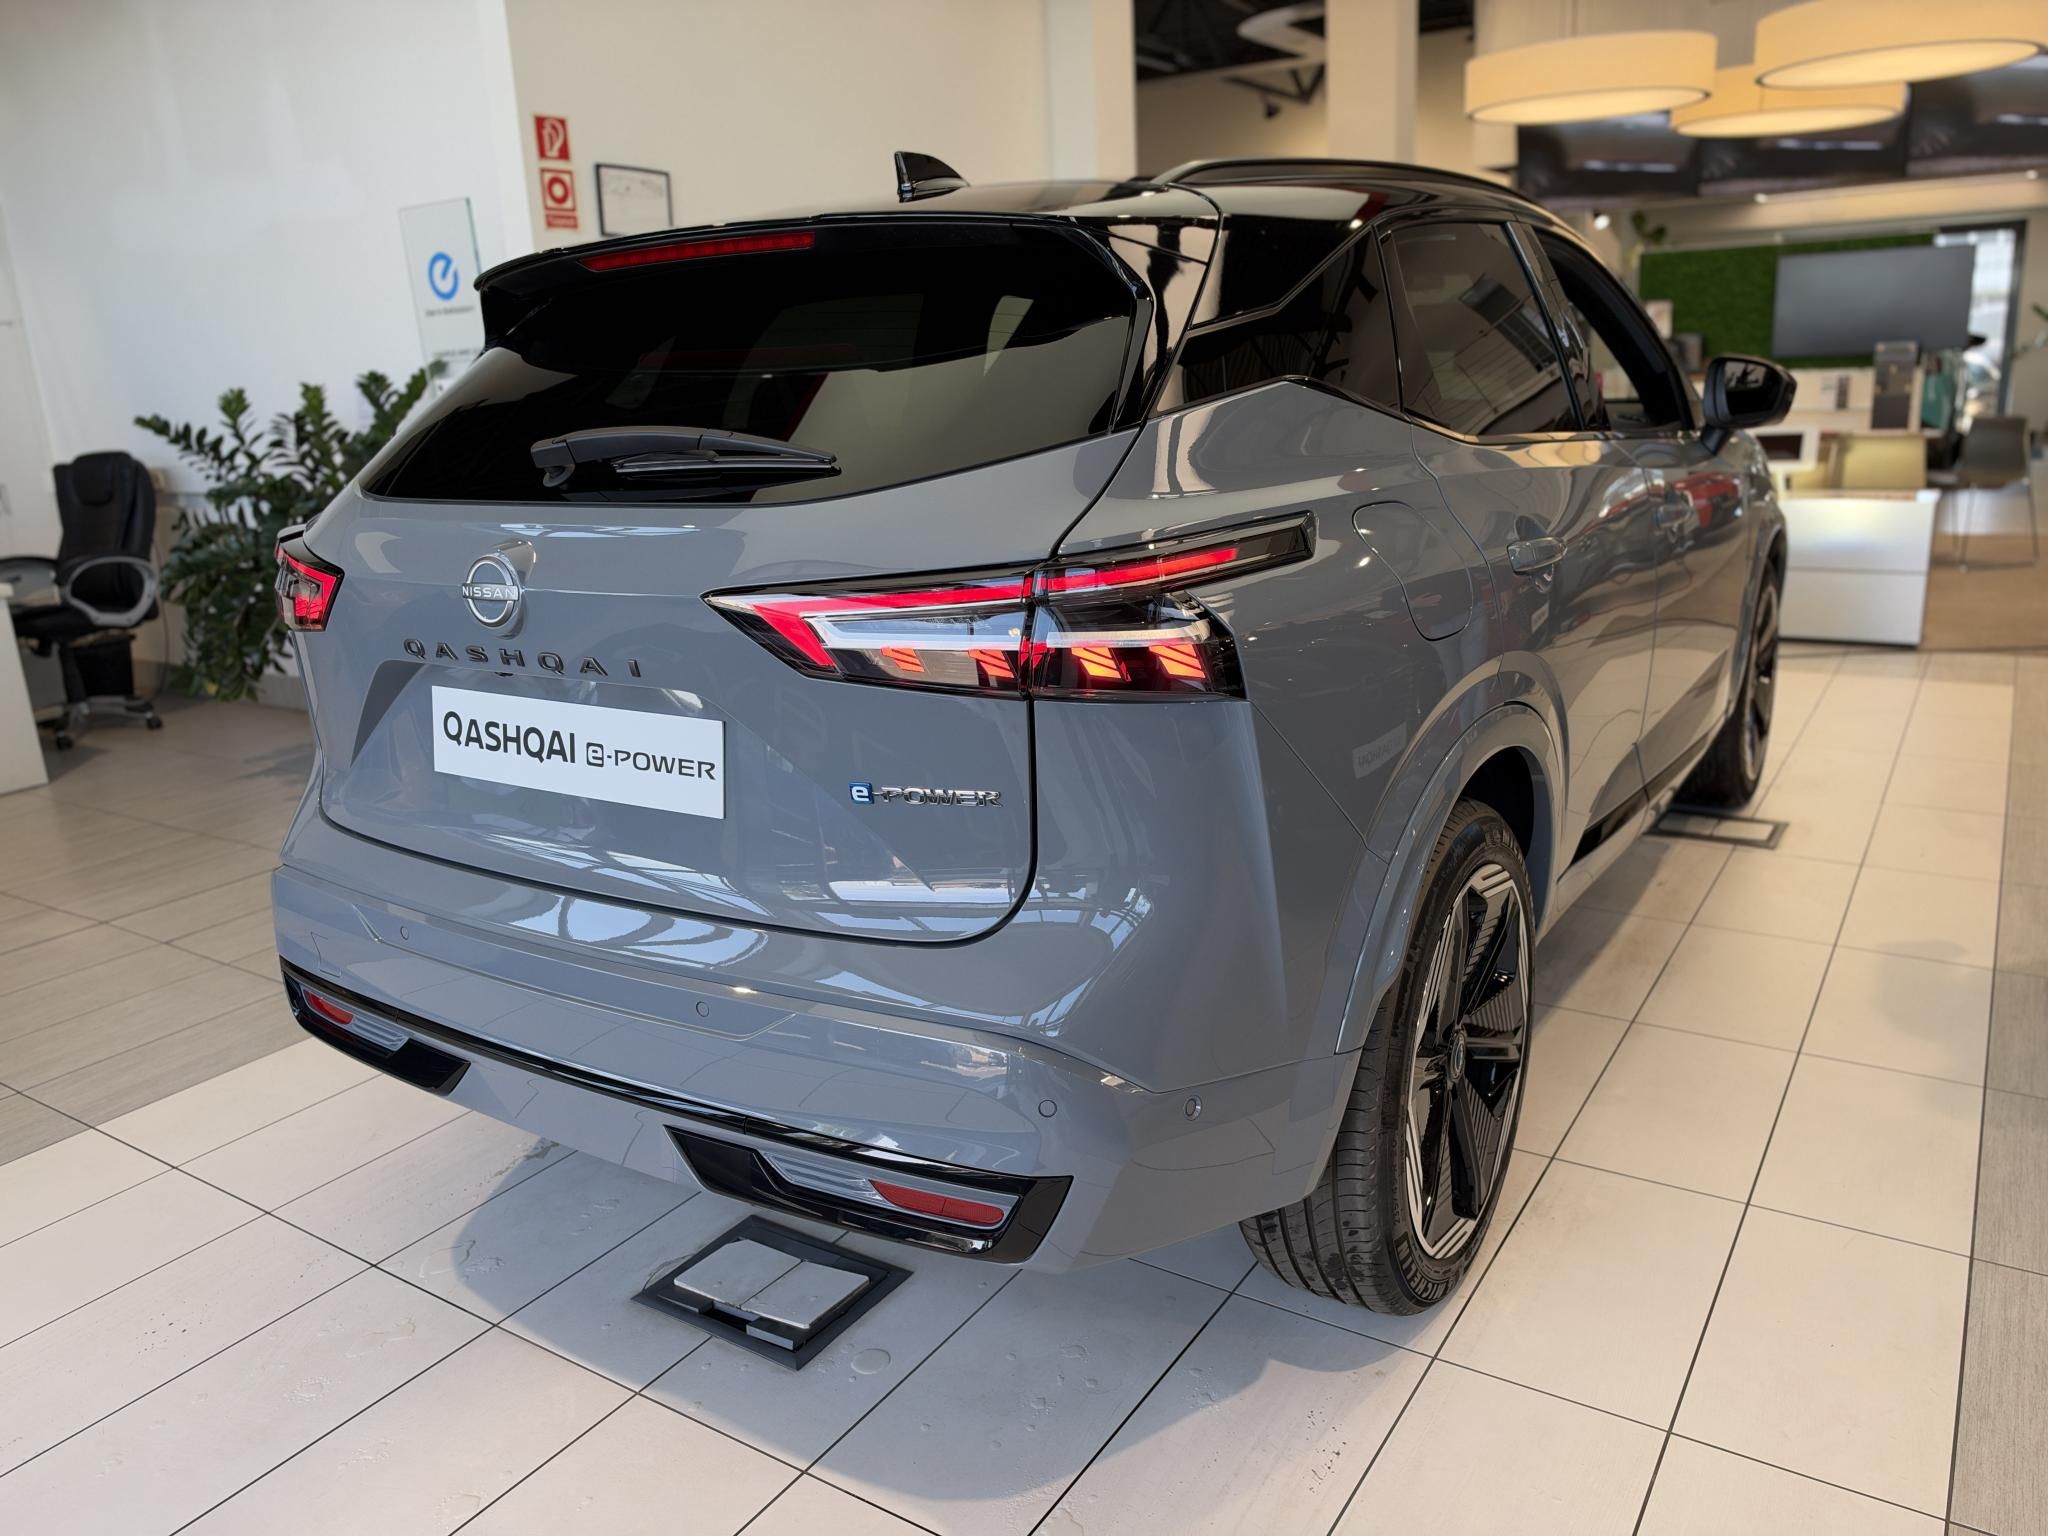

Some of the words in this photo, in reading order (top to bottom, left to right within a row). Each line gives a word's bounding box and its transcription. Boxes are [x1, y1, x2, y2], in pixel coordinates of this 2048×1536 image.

[462, 584, 518, 600] NISSAN
[403, 638, 642, 678] QASHQAI
[443, 710, 576, 764] QASHQAI
[586, 741, 717, 780] e-POWER
[849, 782, 1002, 807] e-POWER
[1397, 1239, 1447, 1300] MICHELIN
